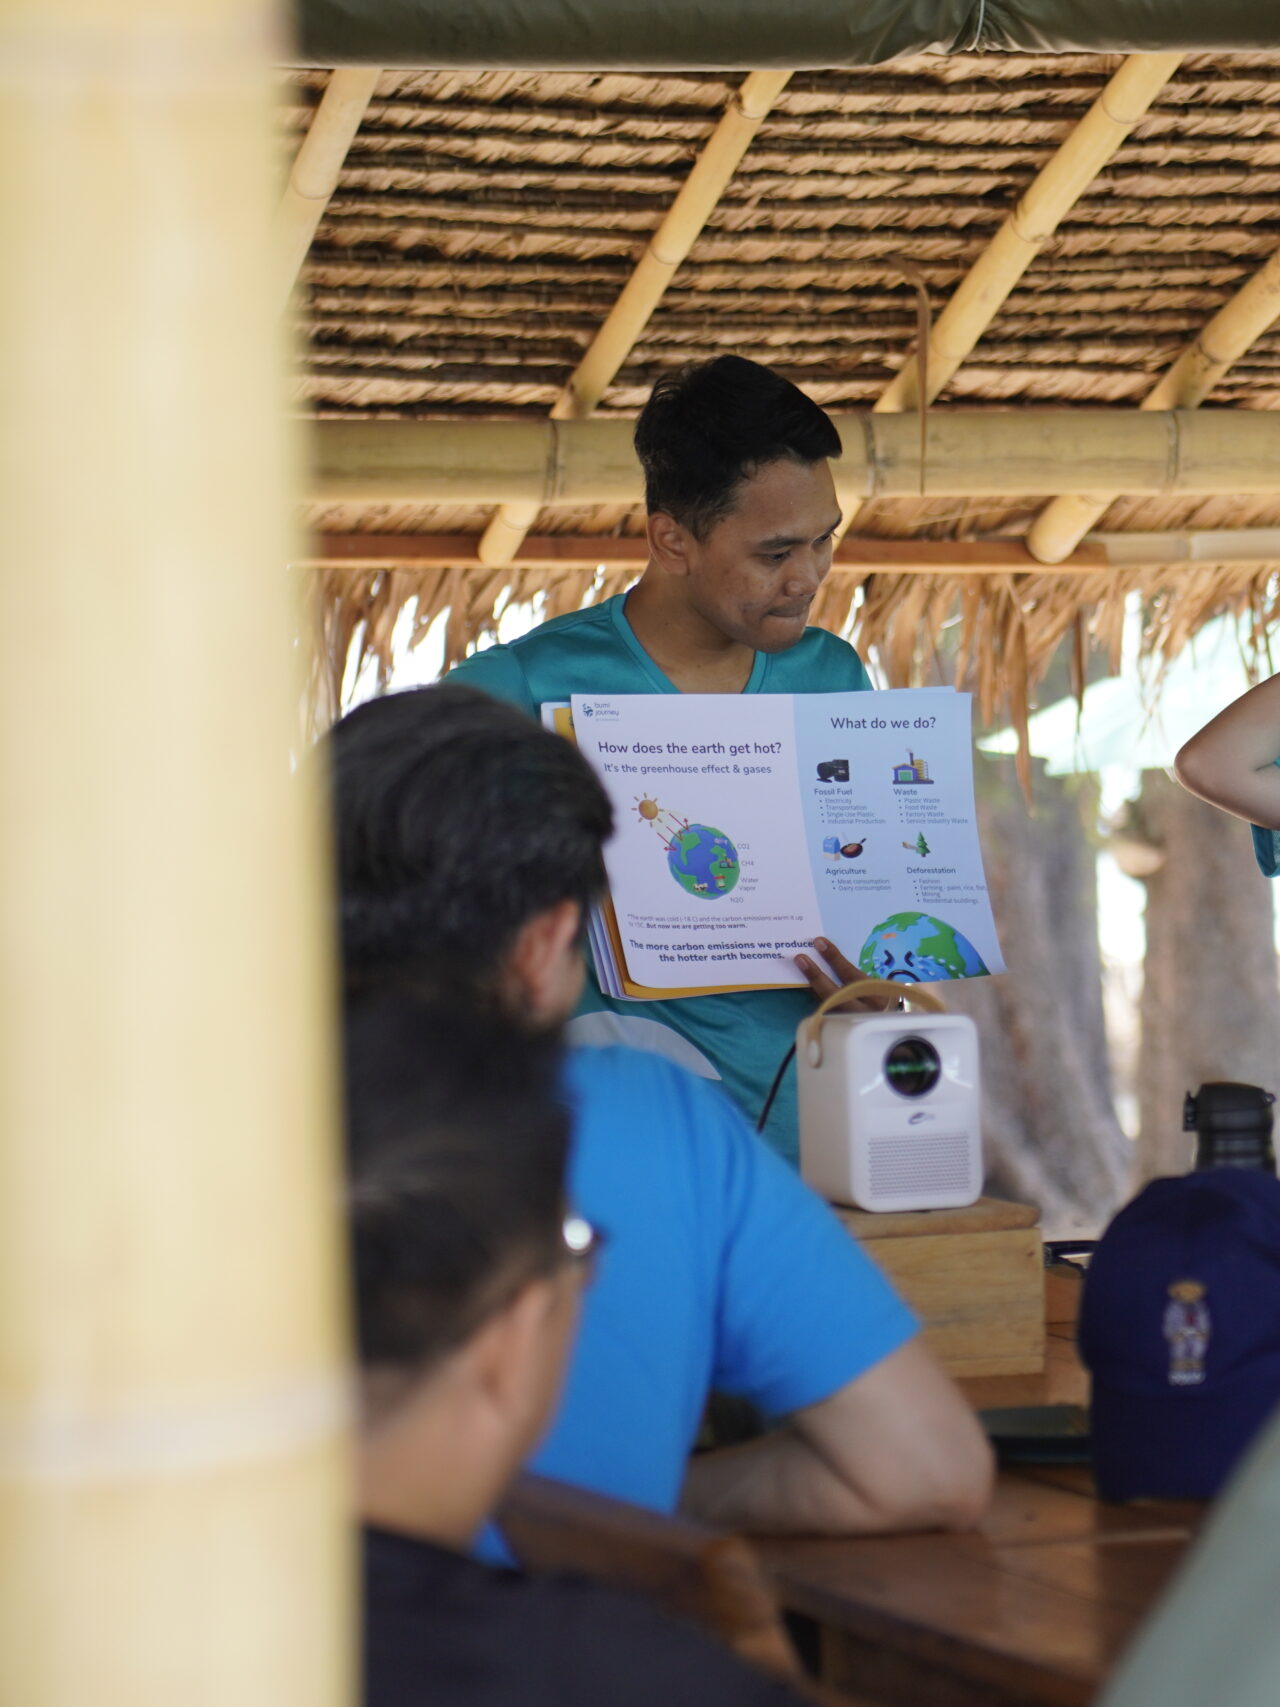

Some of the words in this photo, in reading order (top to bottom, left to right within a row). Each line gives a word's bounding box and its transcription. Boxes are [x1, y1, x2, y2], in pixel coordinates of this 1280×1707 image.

[830, 717, 867, 729] What
[870, 717, 887, 729] do
[890, 720, 910, 729] we
[913, 717, 936, 729] do?
[598, 741, 628, 753] How
[632, 742, 663, 754] does
[667, 743, 688, 754] the
[691, 742, 725, 754] earth
[729, 743, 751, 756] get
[754, 742, 782, 754] hot?
[604, 763, 619, 773] It's
[621, 764, 638, 773] the
[640, 764, 698, 775] greenhouse
[701, 764, 730, 774] effect
[732, 764, 741, 774] &
[743, 766, 772, 775] gases
[814, 788, 835, 796] Fossil
[837, 788, 853, 796] Fuel
[893, 788, 918, 796] Waste
[825, 868, 867, 876] Agriculture
[906, 866, 956, 874] Deforestation
[629, 939, 644, 949] The
[646, 943, 669, 951] more
[672, 943, 705, 951] carbon
[707, 941, 755, 950] emissions
[659, 954, 675, 962] the
[677, 954, 708, 962] hotter
[711, 952, 738, 961] earth
[740, 951, 785, 960] becomes.
